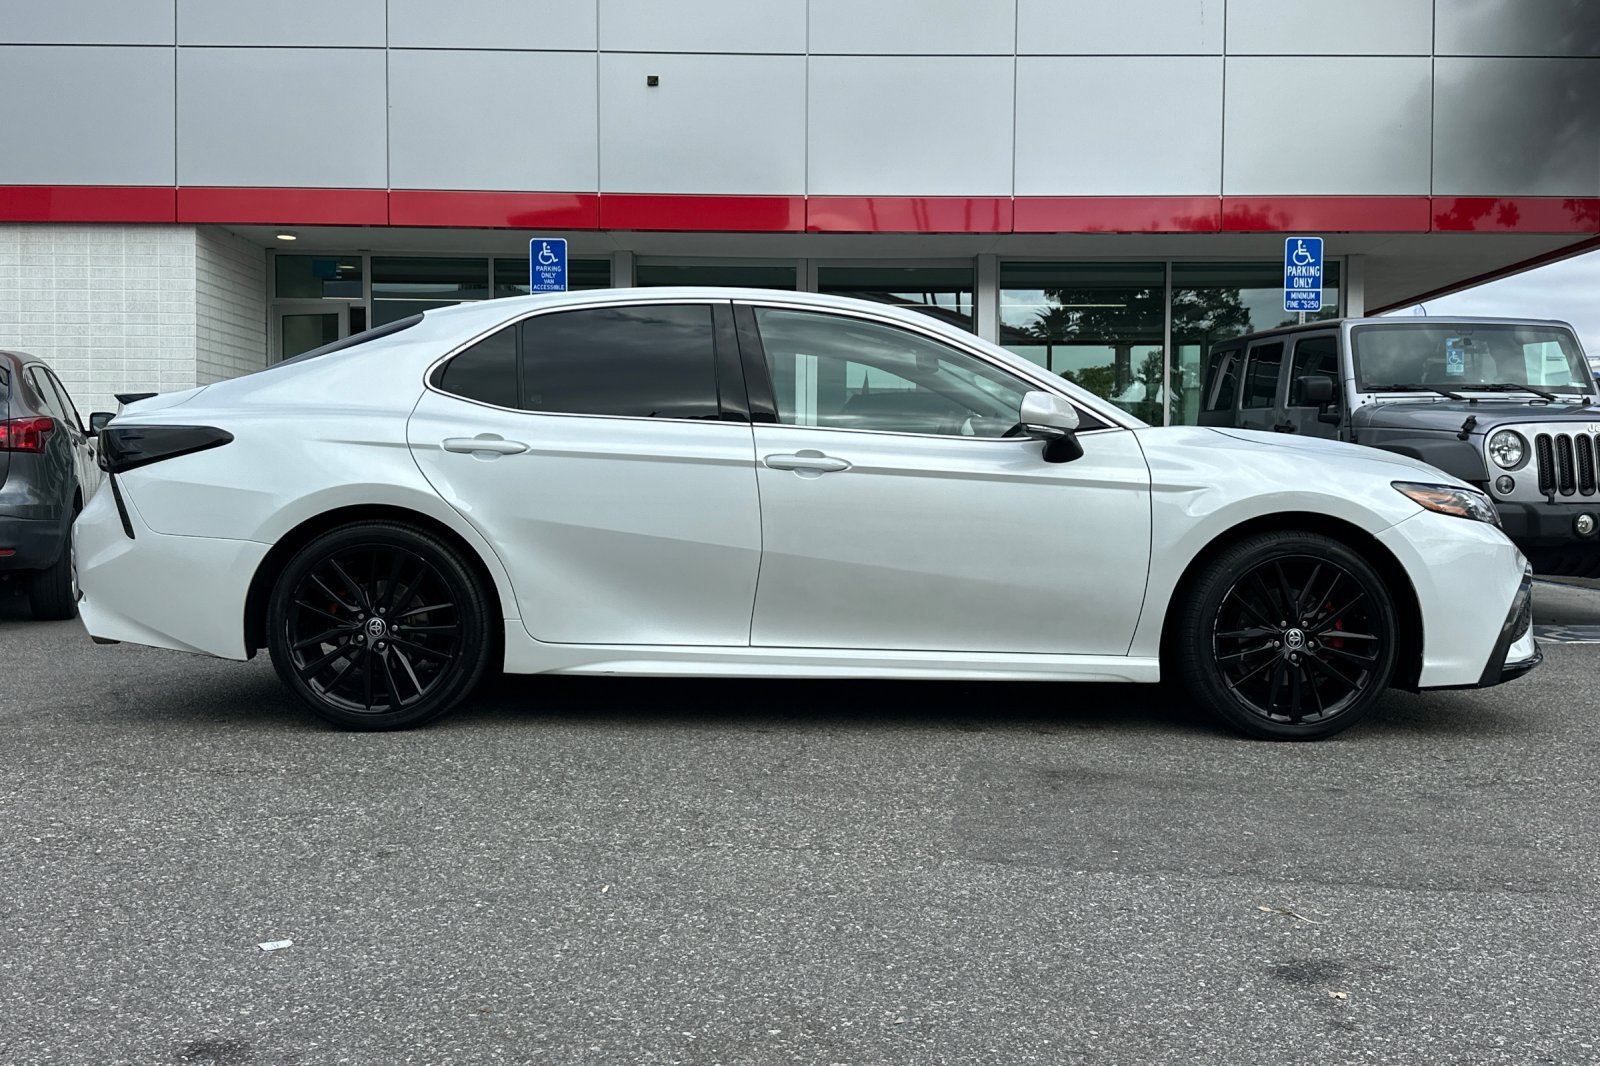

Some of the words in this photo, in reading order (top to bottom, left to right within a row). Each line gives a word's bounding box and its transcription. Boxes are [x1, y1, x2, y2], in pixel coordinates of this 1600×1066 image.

[1287, 266, 1320, 277] PARKING
[1293, 277, 1313, 288] ONLY
[1290, 292, 1316, 300] MINIMUM
[1286, 300, 1299, 308] FINE
